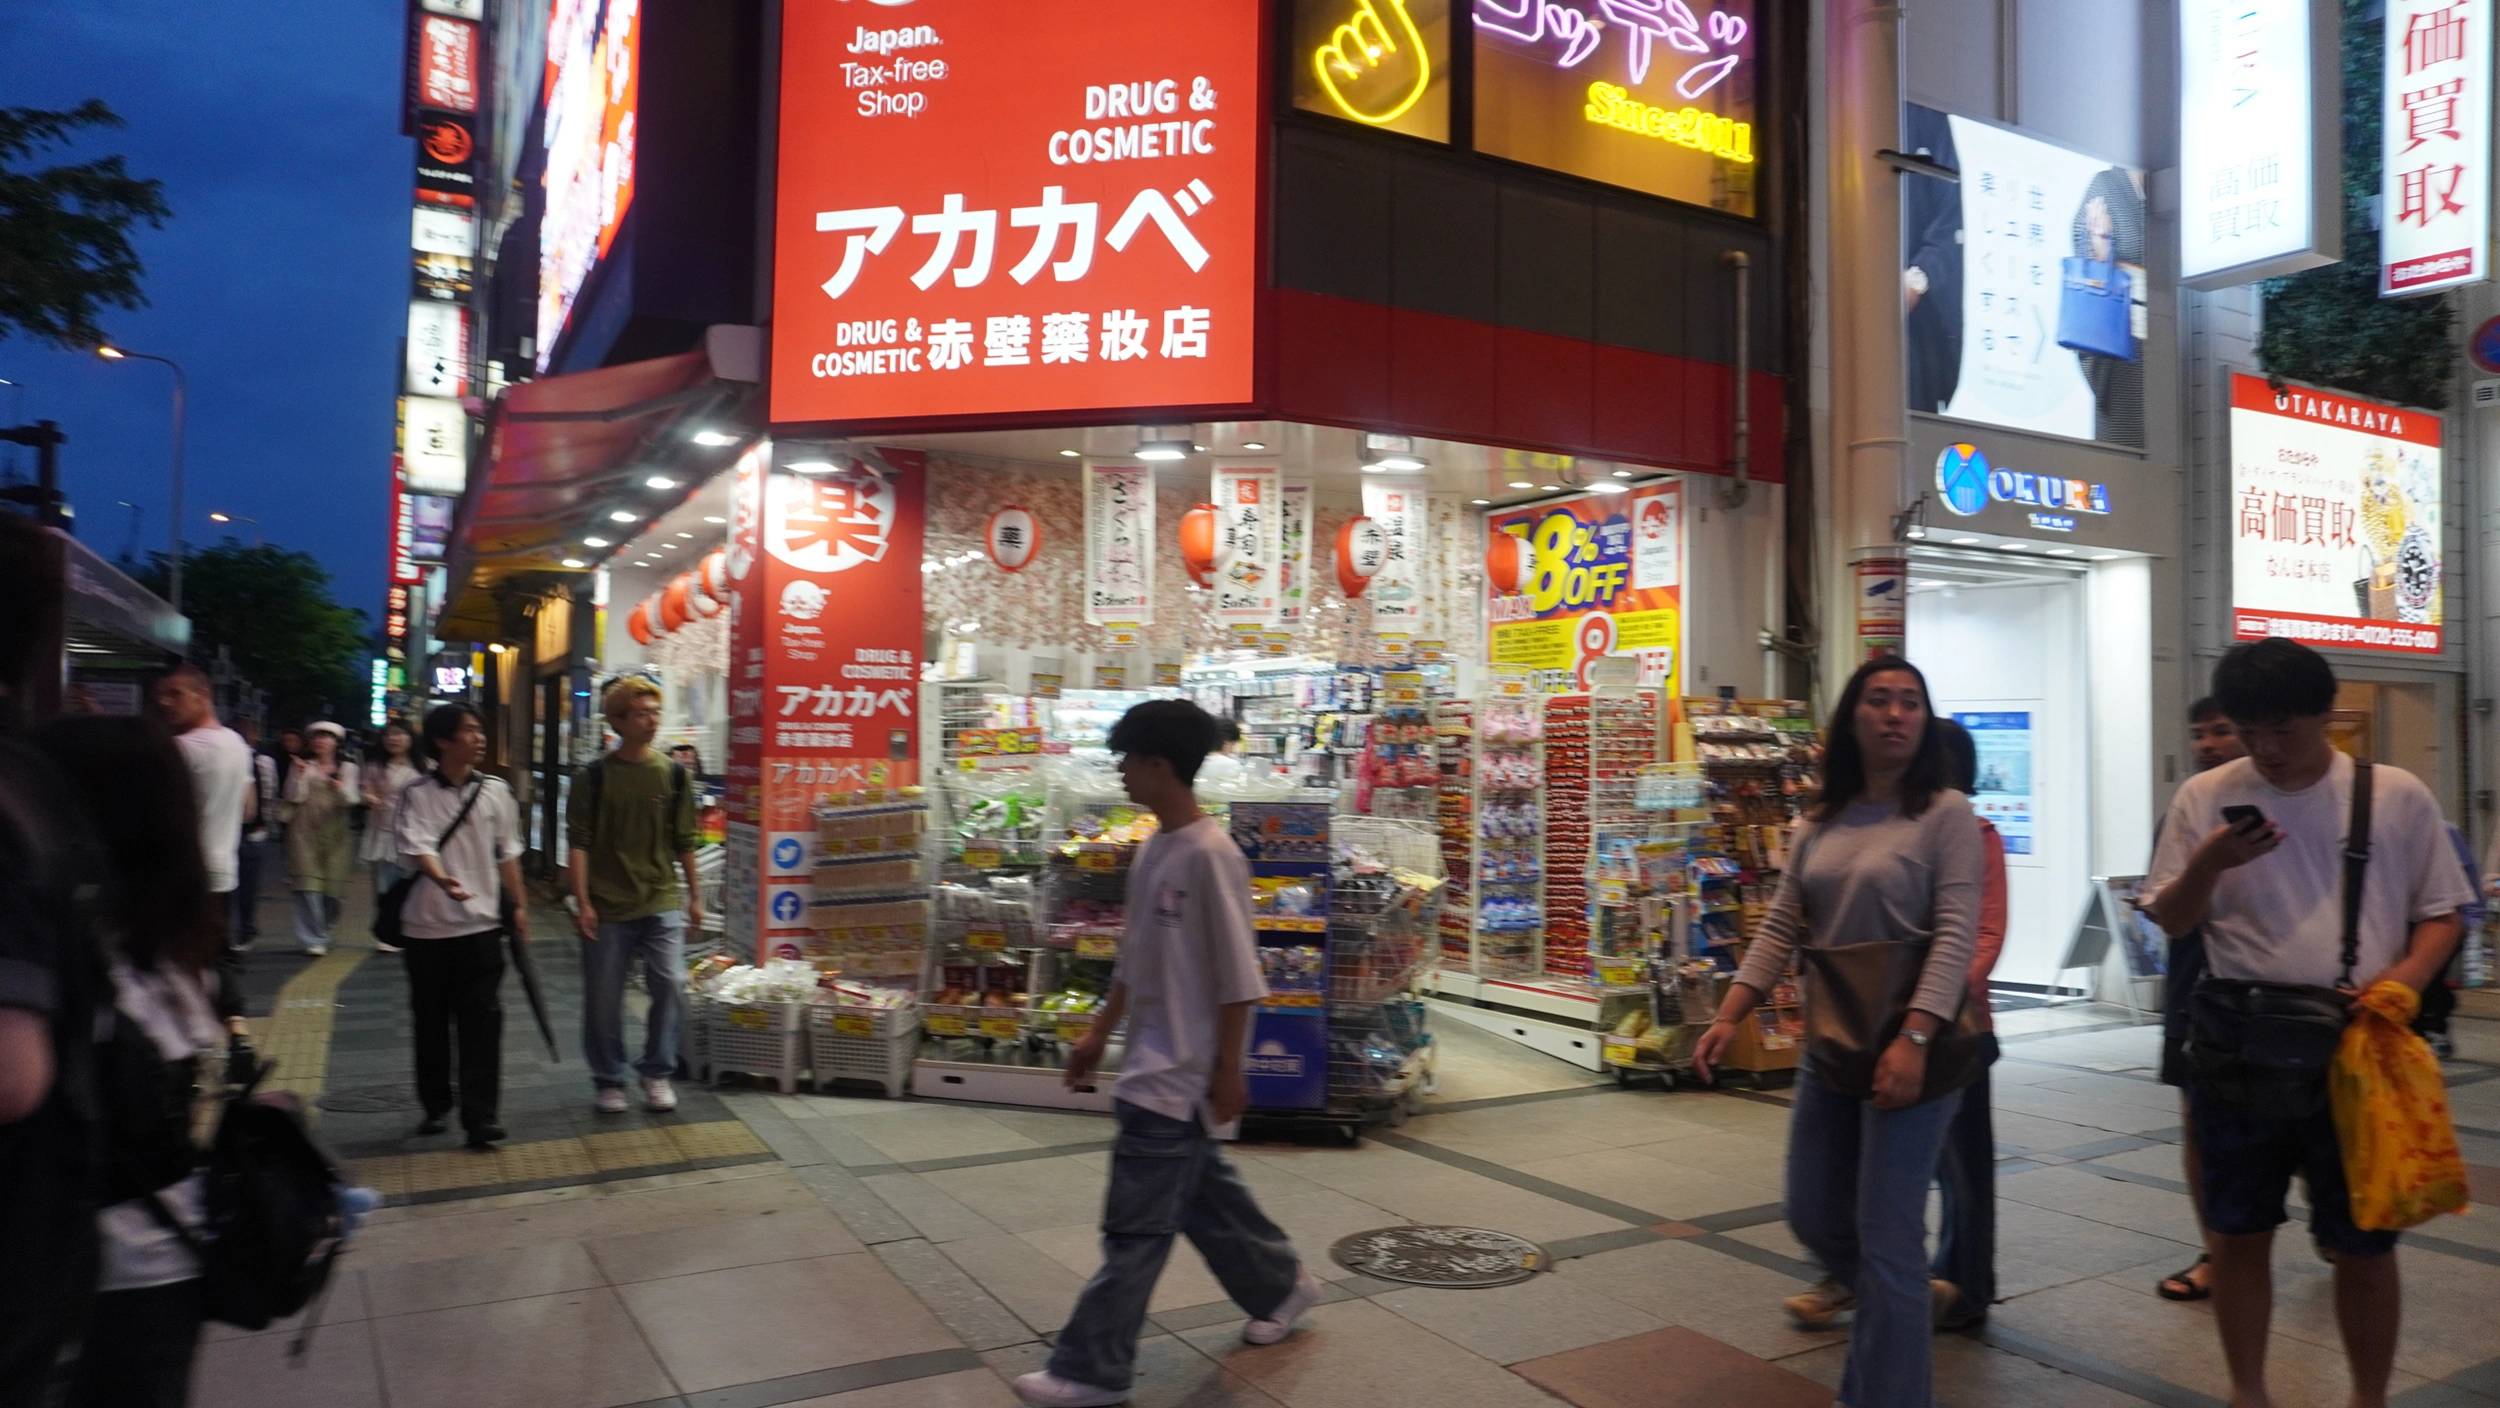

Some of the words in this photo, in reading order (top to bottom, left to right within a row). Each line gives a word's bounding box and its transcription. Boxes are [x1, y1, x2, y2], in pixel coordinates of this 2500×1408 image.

[840, 57, 947, 88] Tax-free
[857, 90, 926, 118] Shop
[1085, 79, 1175, 119] DRUG
[1188, 76, 1216, 110] &
[1048, 119, 1215, 166] COSMETIC
[815, 178, 1213, 300] アカカベ
[836, 319, 898, 347] DRUG
[904, 317, 922, 341] &
[811, 347, 922, 378] COSMETIC
[1988, 466, 2112, 515] OKURA
[2238, 484, 2357, 550] 高価買取
[1564, 561, 1629, 606] OFF
[776, 684, 913, 718] アカカベ
